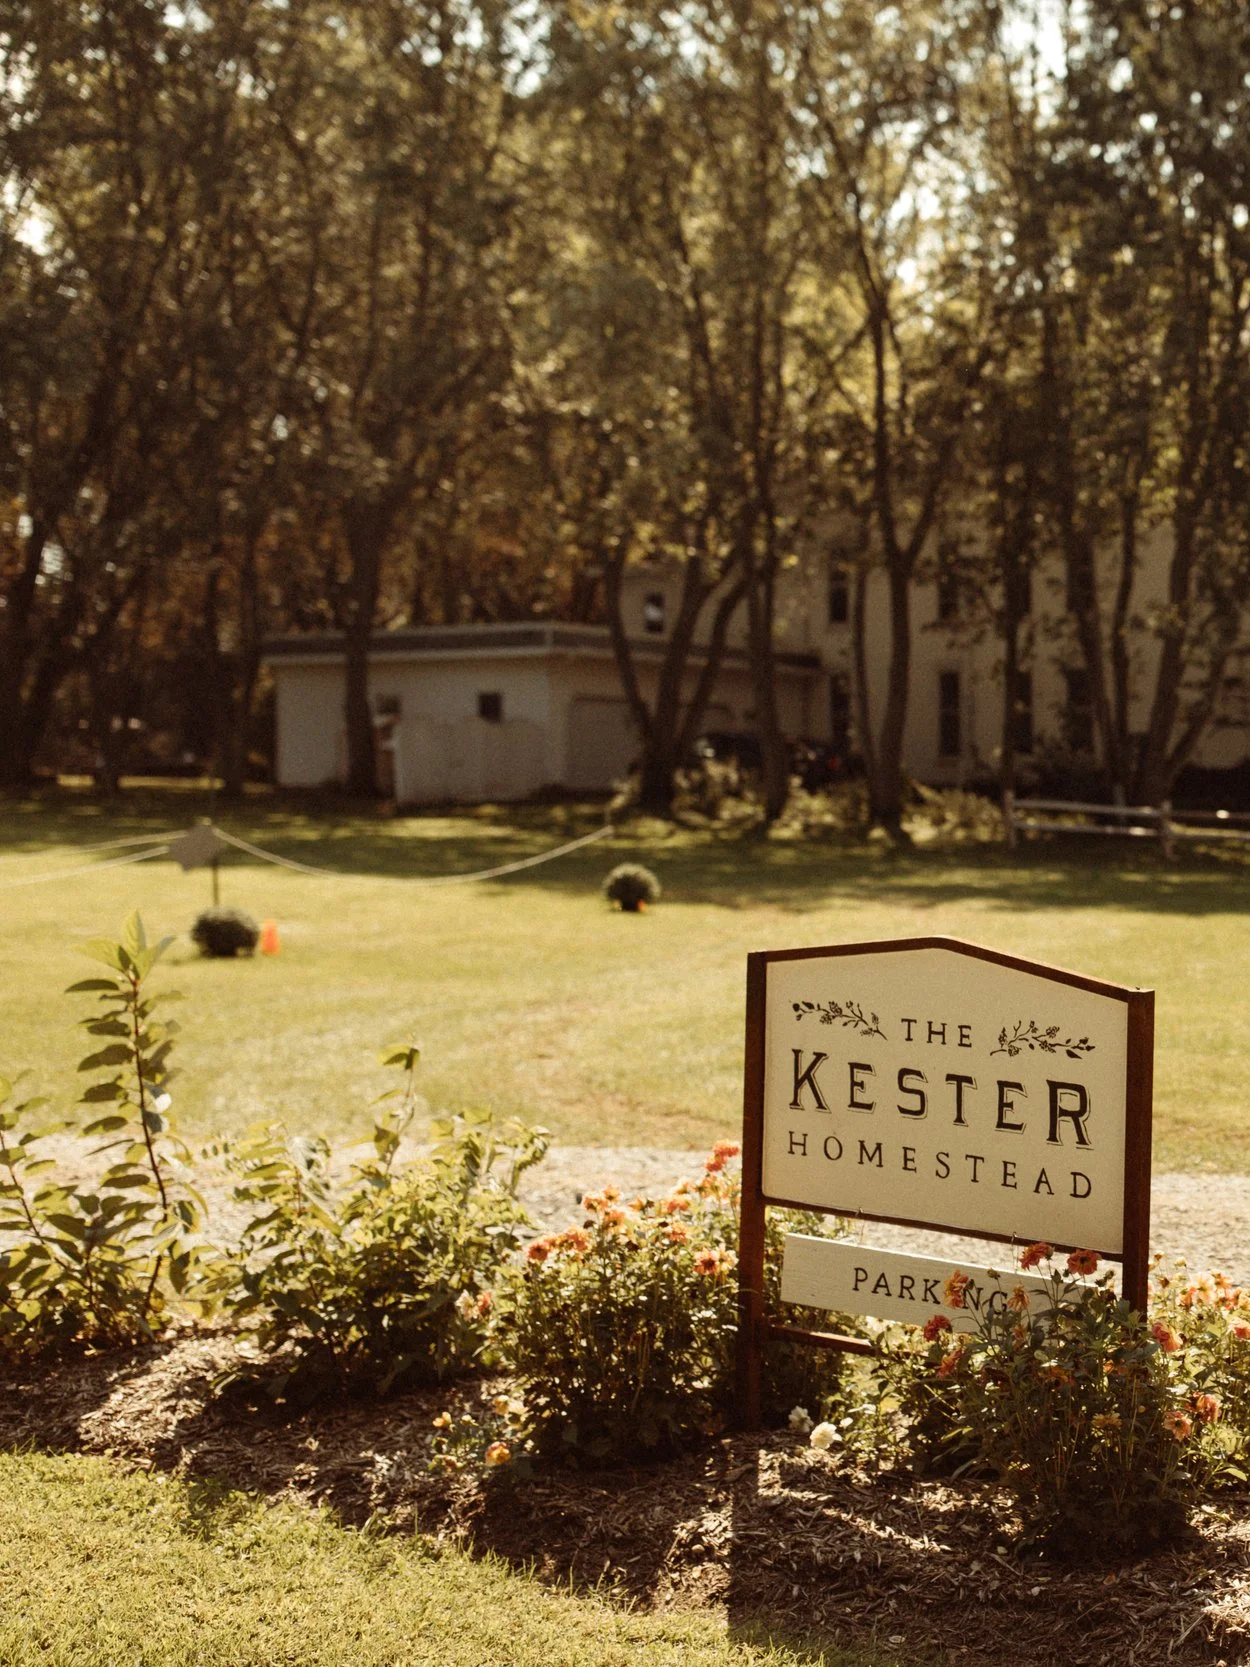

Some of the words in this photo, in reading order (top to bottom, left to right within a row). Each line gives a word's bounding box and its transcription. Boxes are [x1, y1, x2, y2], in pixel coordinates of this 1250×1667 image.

[901, 1017, 973, 1049] THE
[789, 1048, 1095, 1150] KESTER
[787, 1130, 1093, 1199] HOMESTEAD
[851, 1266, 1009, 1316] PARKNG
